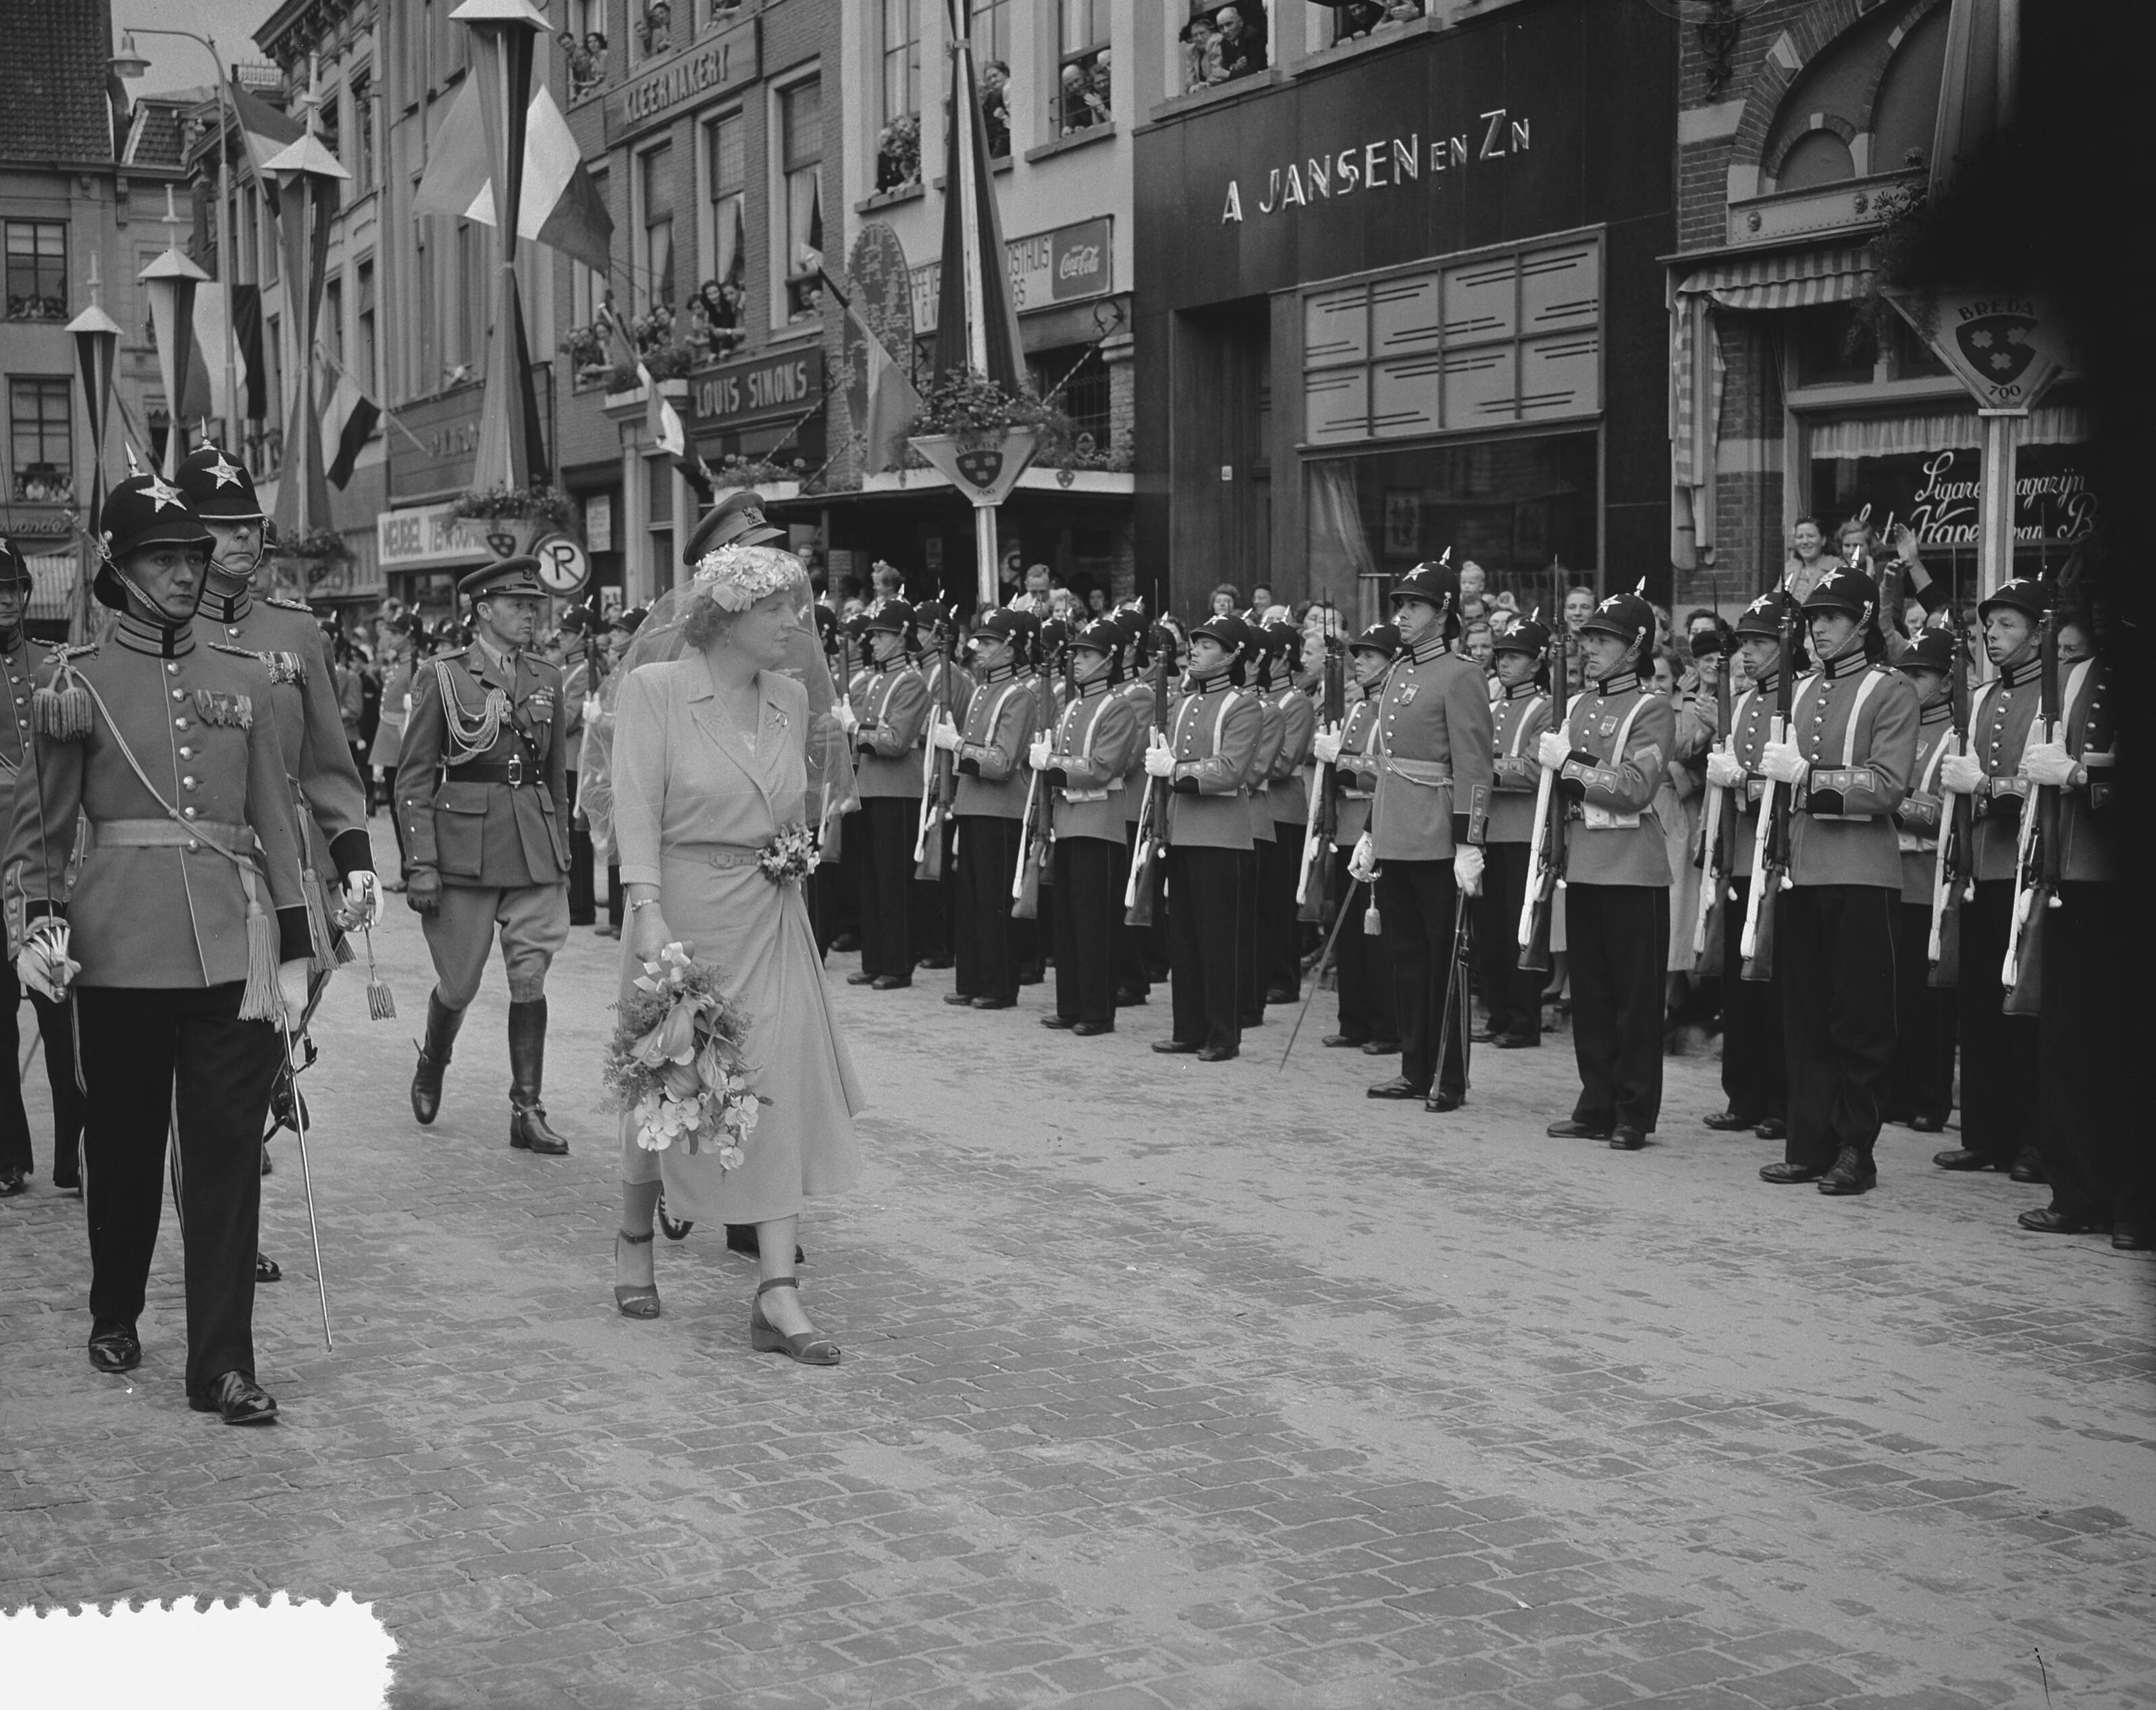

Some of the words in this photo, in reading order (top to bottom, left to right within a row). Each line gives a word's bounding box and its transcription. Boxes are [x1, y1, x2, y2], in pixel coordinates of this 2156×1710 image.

[1221, 180, 1243, 223] A
[1259, 133, 1418, 214] JANSEN
[1430, 134, 1467, 171] EN
[1957, 297, 2035, 322] BREDA
[695, 376, 740, 418] LOUIS
[747, 361, 808, 408] SIMONS
[1989, 384, 2022, 400] 700
[553, 545, 575, 580] P
